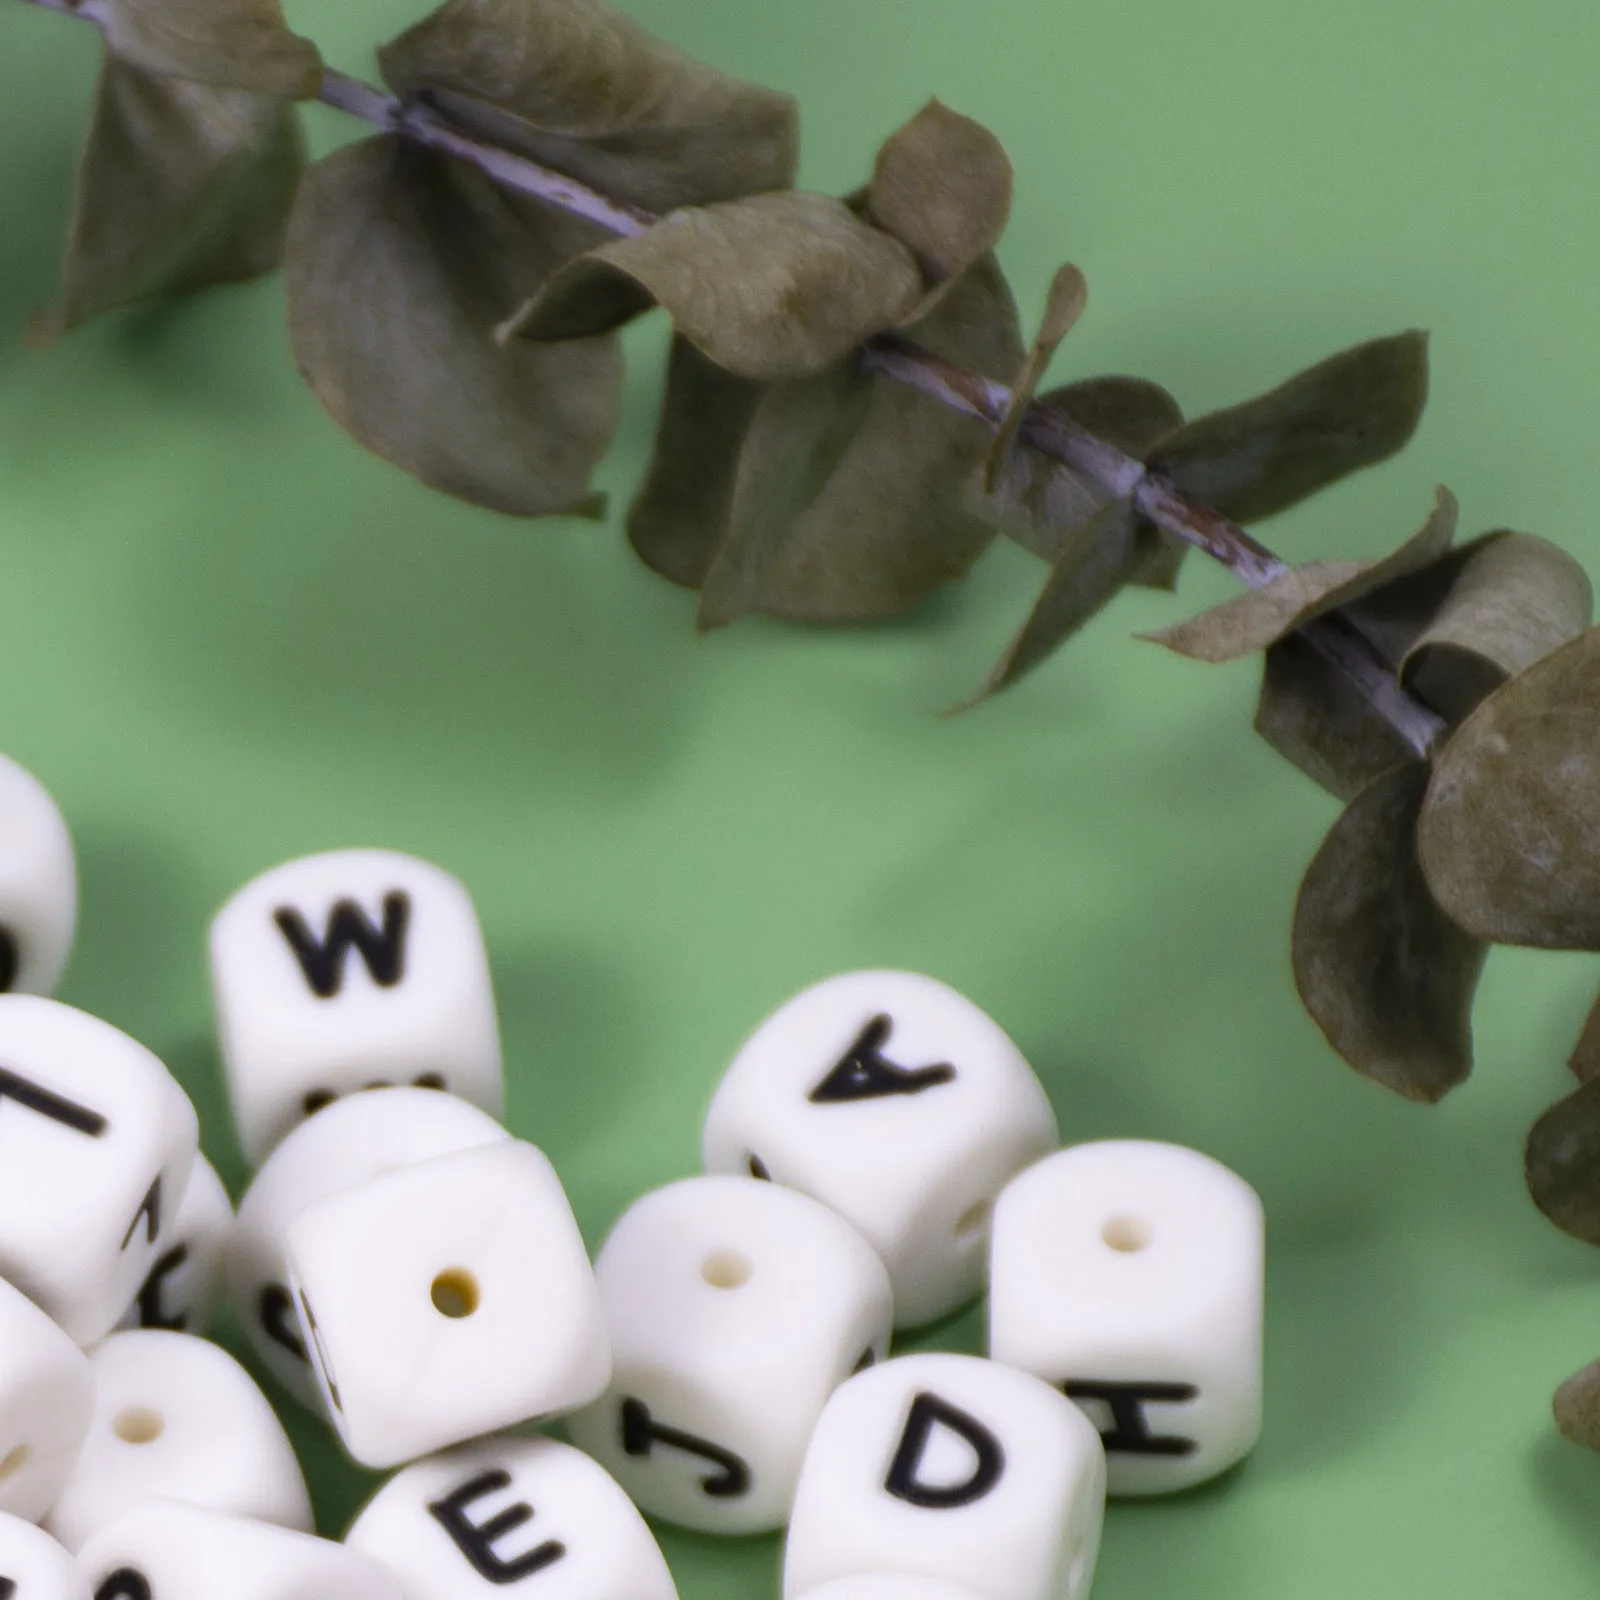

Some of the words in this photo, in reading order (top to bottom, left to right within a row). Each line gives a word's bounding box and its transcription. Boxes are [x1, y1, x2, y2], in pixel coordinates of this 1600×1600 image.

[274, 890, 409, 998] W
[810, 1014, 954, 1103] A
[884, 1392, 1005, 1509] D
[428, 1468, 566, 1584] E
